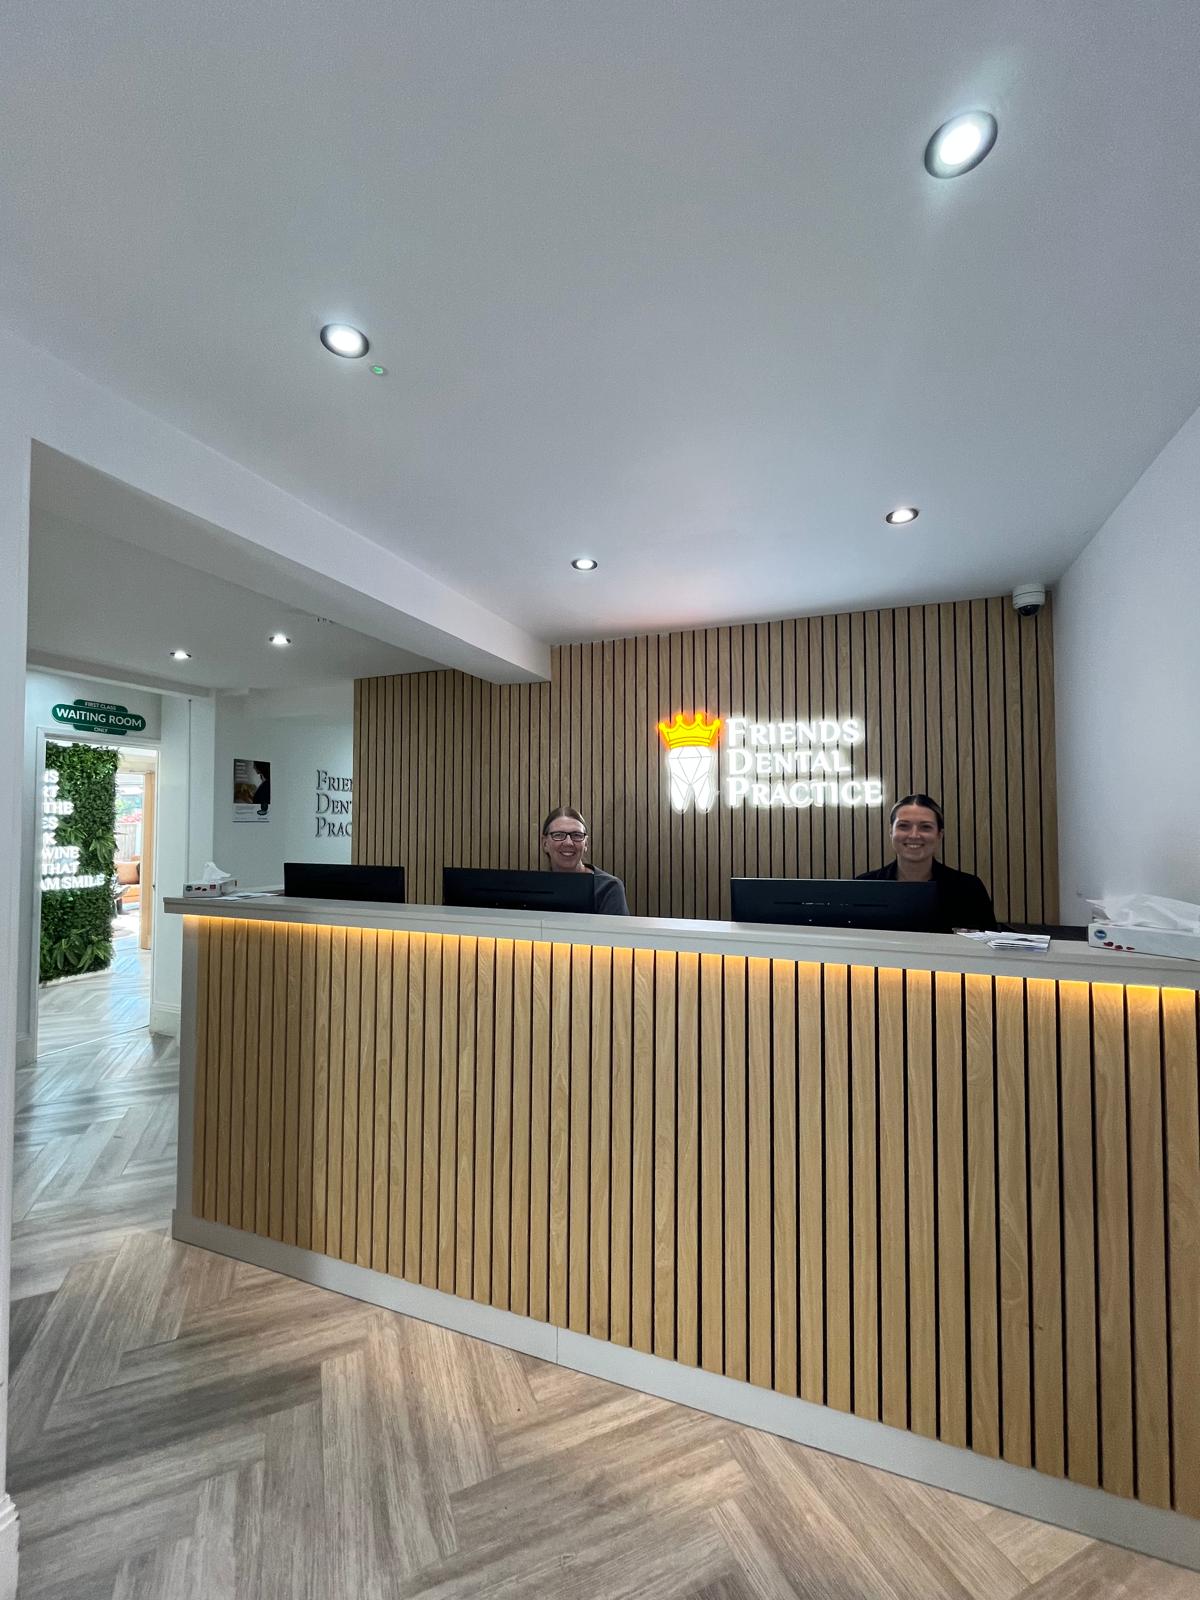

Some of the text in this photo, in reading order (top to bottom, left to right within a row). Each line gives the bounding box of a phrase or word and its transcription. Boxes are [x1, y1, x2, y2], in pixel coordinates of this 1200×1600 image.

[56, 707, 142, 728] WAITING ROOM
[100, 703, 117, 711] CLASS
[725, 717, 861, 747] FRIENDS
[725, 749, 851, 775] DENTAL
[725, 777, 883, 807] PRACTICE
[316, 793, 352, 814] DEN
[62, 874, 105, 889] SMILE
